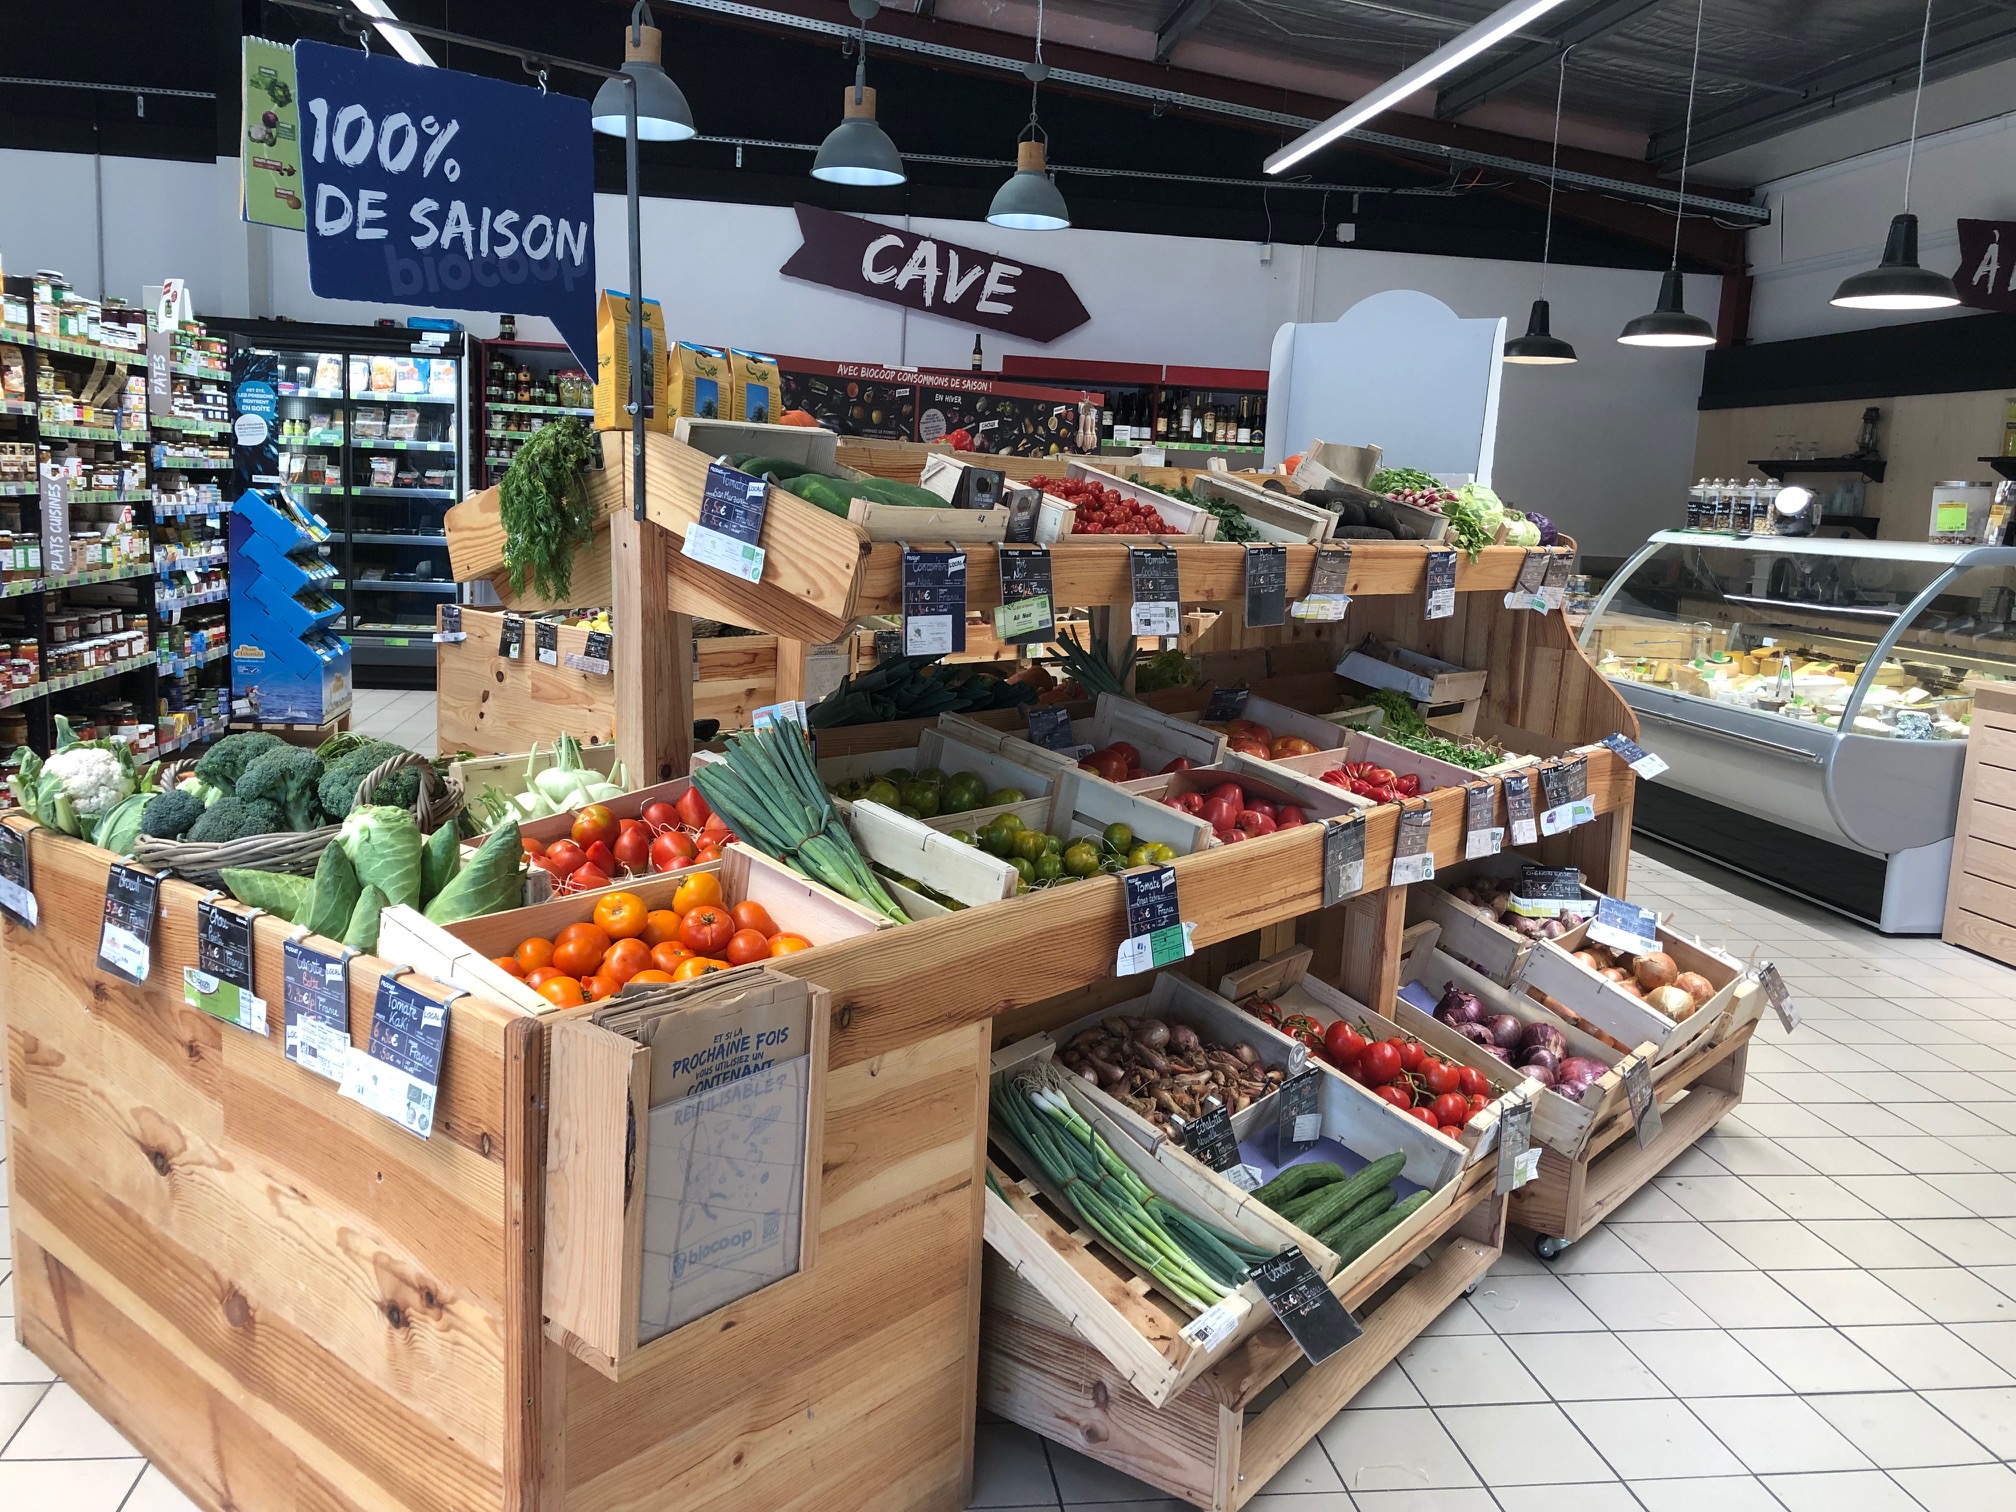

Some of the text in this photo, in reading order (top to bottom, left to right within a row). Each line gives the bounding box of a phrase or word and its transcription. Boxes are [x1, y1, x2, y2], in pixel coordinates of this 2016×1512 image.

[308, 98, 461, 182] 100%
[315, 183, 588, 266] DE SAISON
[385, 244, 590, 296] biocoop
[1972, 229, 2000, 294] À
[862, 234, 1023, 315] CAVE
[837, 364, 859, 377] AVEC
[860, 367, 896, 382] BIOCOOP
[897, 372, 949, 388] CONSOMMONS
[950, 380, 961, 388] DE
[962, 380, 987, 392] SAISON
[935, 394, 962, 405] EN HIVER
[748, 485, 764, 493] LOCAL
[49, 536, 66, 571] PLATS
[950, 560, 963, 568] LOCAL
[1135, 876, 1160, 892] Tomate
[285, 945, 299, 954] PRODUIT
[326, 967, 341, 976] LOCAL
[381, 980, 396, 991] PRODUIT
[318, 1002, 340, 1017] France
[387, 990, 417, 1021] Tomate
[424, 1011, 441, 1021] LOCAL
[714, 1027, 743, 1044] ET SI LA
[409, 1045, 434, 1068] France
[672, 1026, 790, 1078] PROCHAINE FOIS
[686, 1059, 776, 1097] CONTENANT
[695, 1051, 764, 1080] VOUS UTILISIEZ UN
[776, 1073, 787, 1091] ?
[688, 1229, 752, 1266] biocoop
